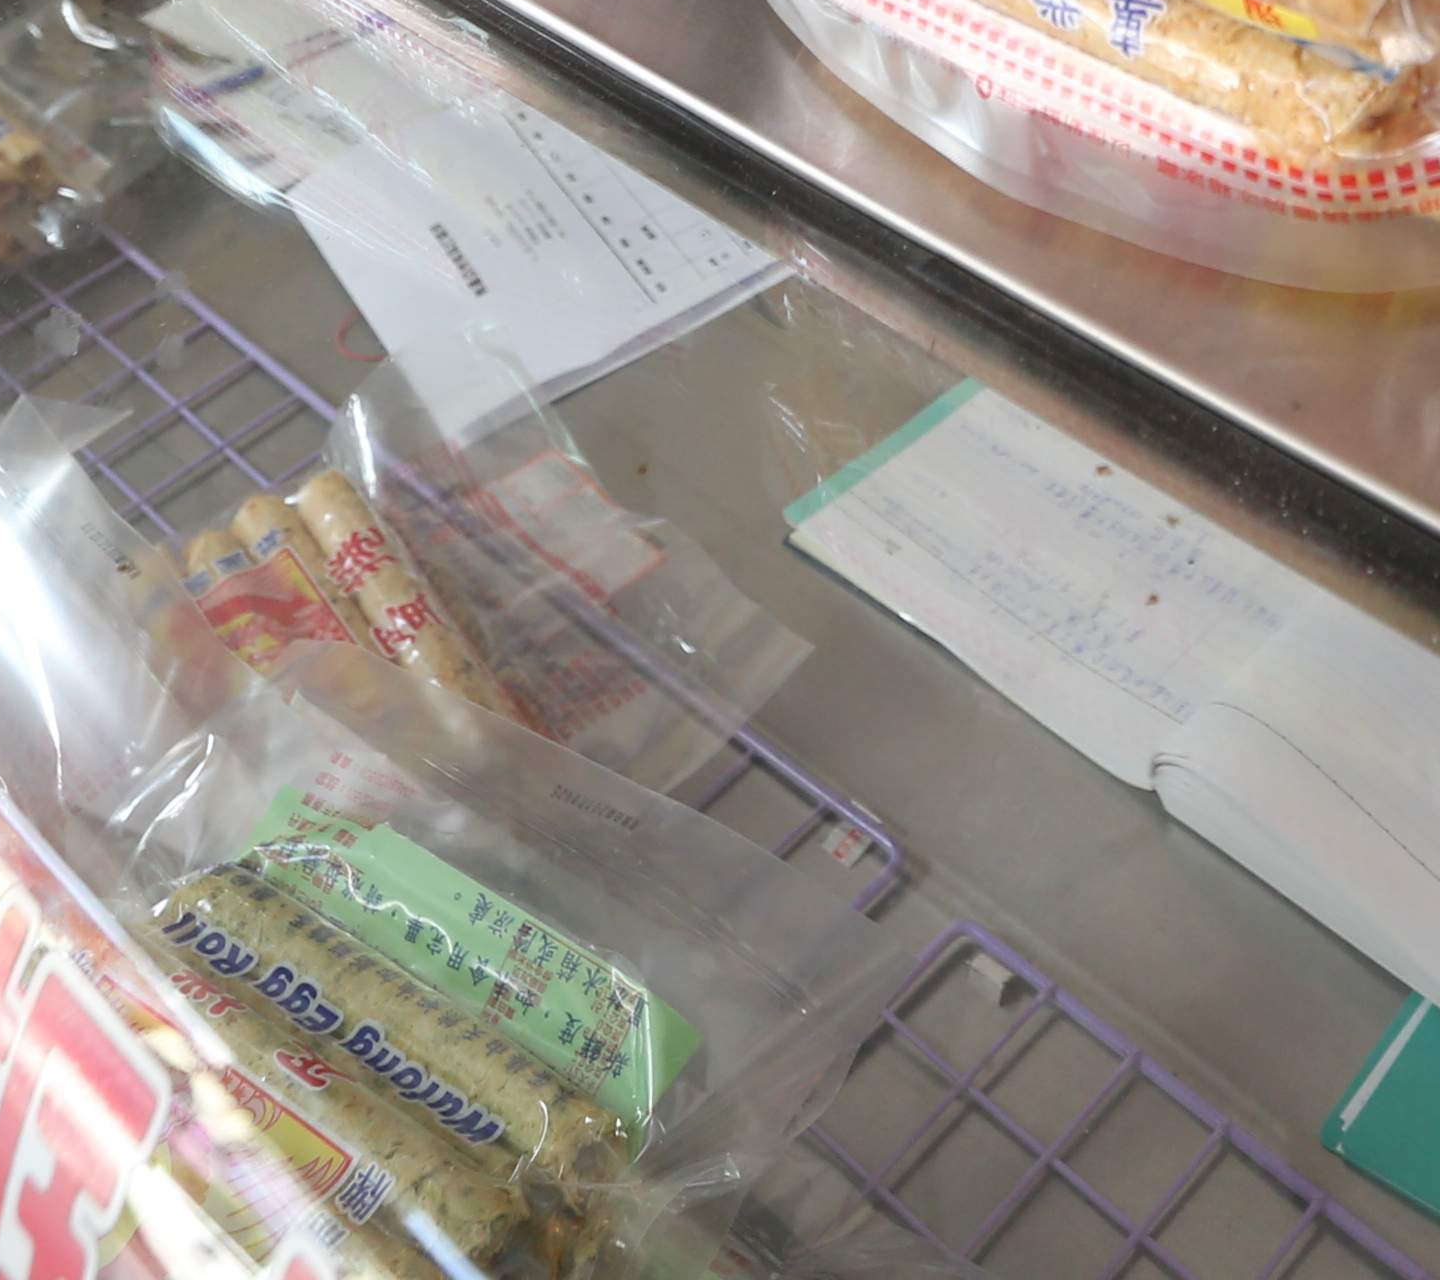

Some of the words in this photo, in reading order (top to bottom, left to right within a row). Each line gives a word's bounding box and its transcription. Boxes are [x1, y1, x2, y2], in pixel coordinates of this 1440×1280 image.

[164, 912, 258, 975] Roll
[255, 965, 344, 1033] Egg
[342, 1022, 504, 1144] Wufong
